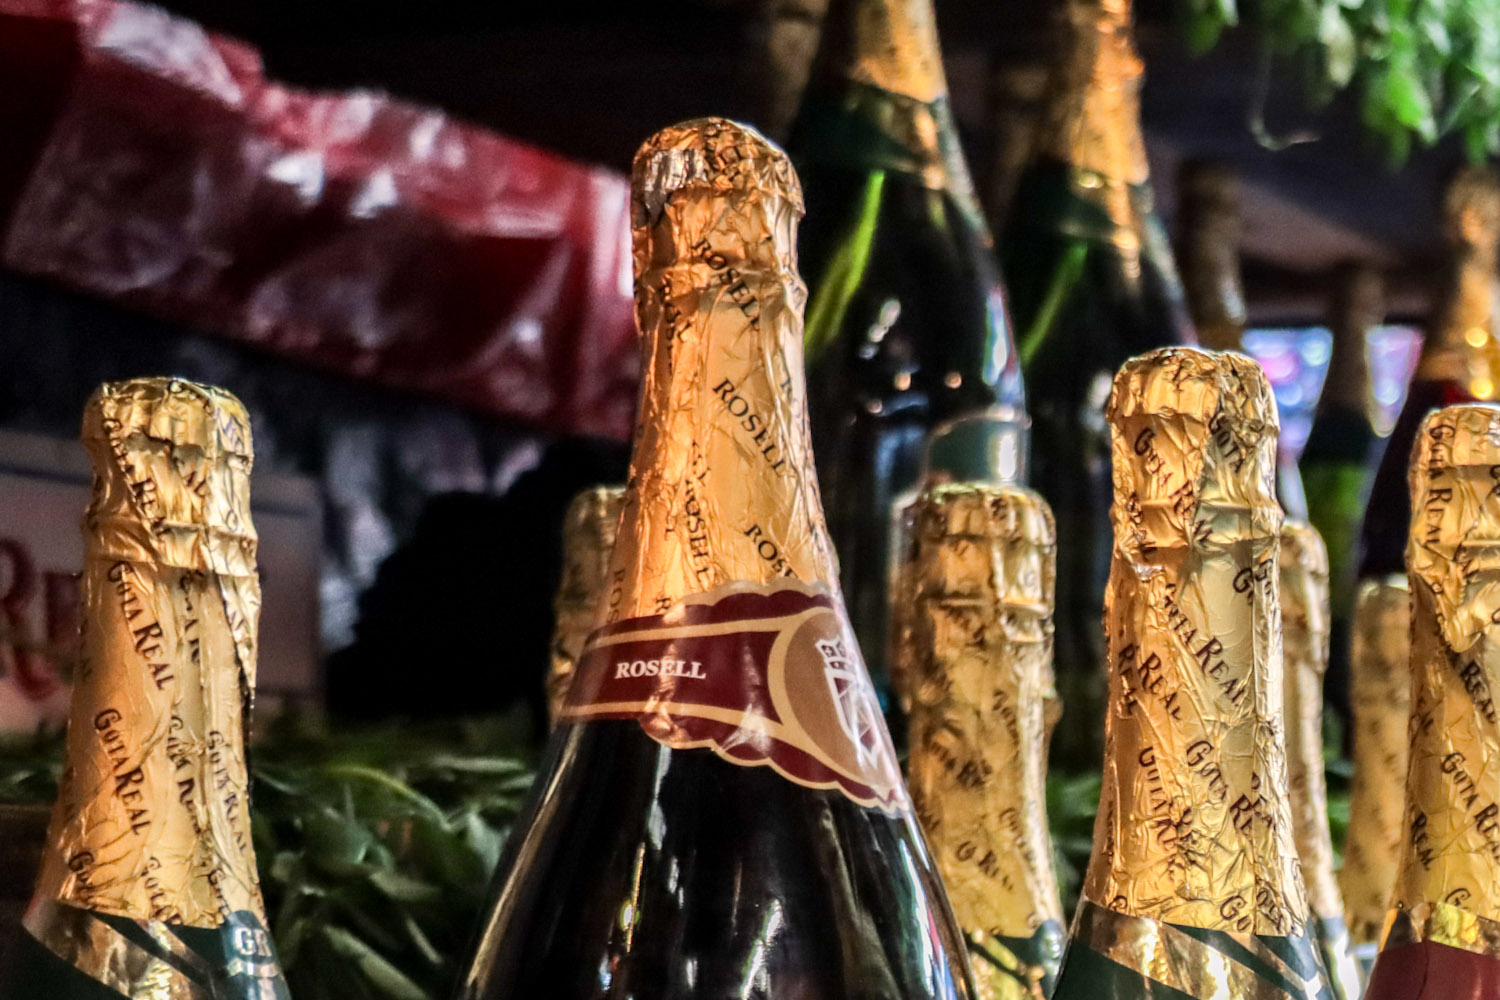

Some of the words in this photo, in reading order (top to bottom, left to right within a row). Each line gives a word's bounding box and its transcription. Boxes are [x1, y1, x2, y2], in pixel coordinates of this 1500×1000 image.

[713, 377, 786, 478] ROSELL
[107, 560, 143, 622] GOTA
[132, 621, 176, 692] REAL
[615, 657, 707, 683] ROSELL
[1197, 636, 1247, 708] REAL
[94, 707, 131, 774] GOTA
[113, 763, 152, 837] REAL
[1440, 751, 1480, 808] GOTA
